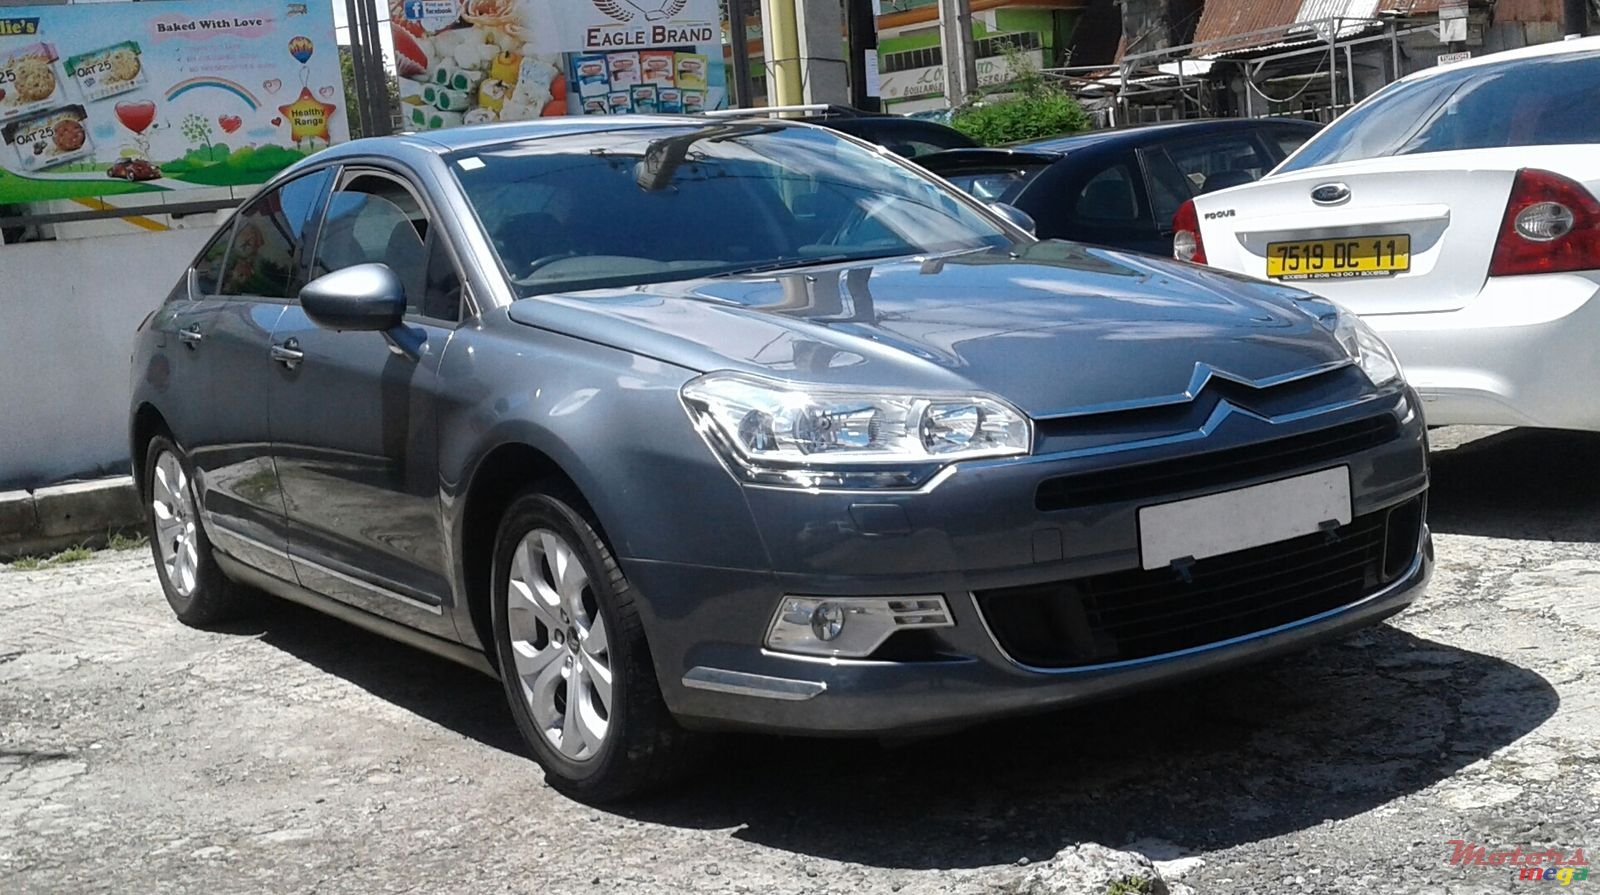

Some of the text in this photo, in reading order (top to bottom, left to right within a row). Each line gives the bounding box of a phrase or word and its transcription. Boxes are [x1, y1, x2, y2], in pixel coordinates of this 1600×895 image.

[157, 18, 263, 32] Baked With Love
[587, 25, 713, 47] EAGLE BRAND
[77, 61, 112, 77] OAT 25
[291, 108, 325, 118] Healthy
[294, 117, 324, 126] Range
[16, 126, 54, 145] OAT 25
[1204, 209, 1236, 220] FOCUS
[1277, 240, 1396, 271] 7519 DC 11
